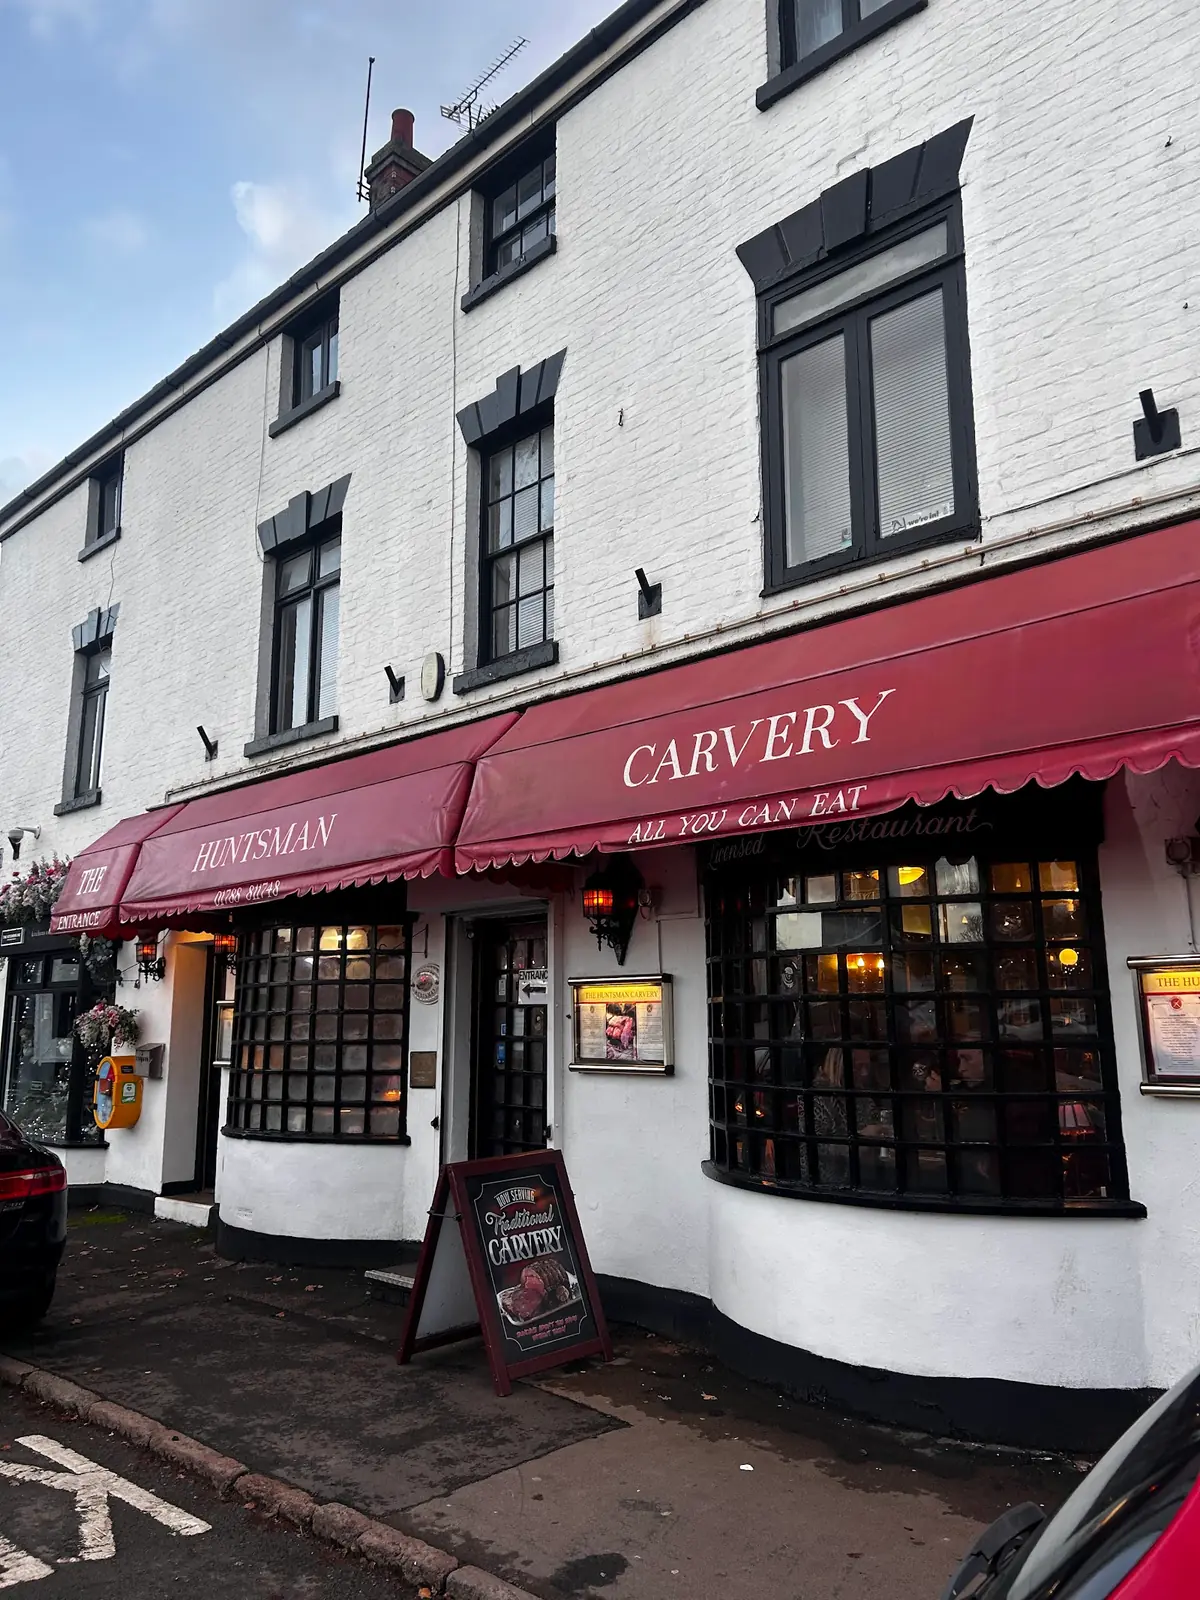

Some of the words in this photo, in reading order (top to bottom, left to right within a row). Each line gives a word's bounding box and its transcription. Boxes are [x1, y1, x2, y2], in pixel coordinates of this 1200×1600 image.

[623, 688, 896, 788] CARVERY
[627, 821, 666, 845] ALL
[677, 808, 729, 836] YOU
[738, 797, 799, 827] CAN
[808, 785, 868, 816] EAT
[796, 806, 993, 851] Restaurant
[191, 813, 338, 873] HUNTSMAN
[77, 865, 107, 896] THE
[213, 890, 241, 908] 01788
[57, 910, 101, 932] ENTRANCE
[597, 991, 630, 999] HUNTSMAN
[631, 990, 658, 998] CARVERY
[1156, 977, 1180, 987] THE
[511, 1188, 535, 1203] SERVING
[485, 1204, 554, 1236] Traditional
[488, 1226, 563, 1265] CARVERY
